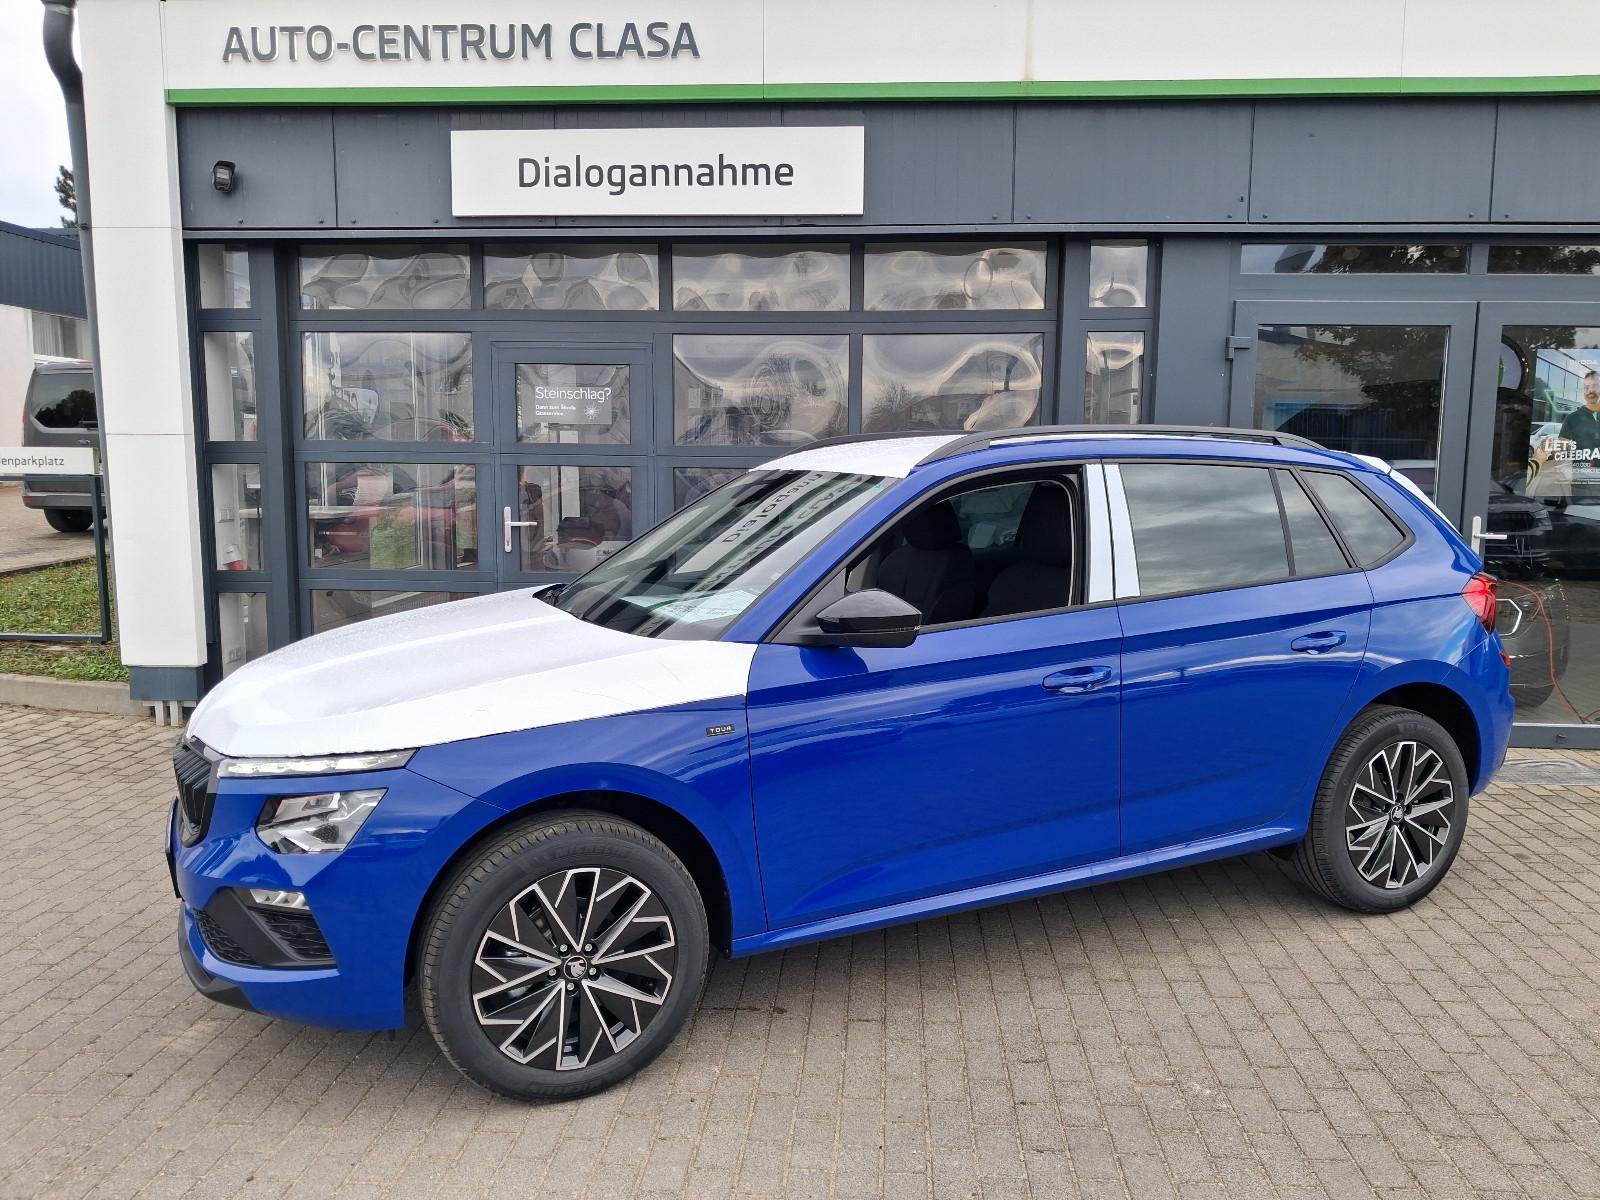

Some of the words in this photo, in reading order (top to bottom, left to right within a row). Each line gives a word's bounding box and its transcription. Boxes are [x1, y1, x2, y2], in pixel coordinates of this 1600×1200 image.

[222, 23, 553, 62] AUTO-CENTRUM
[568, 22, 700, 60] CLASA
[518, 153, 794, 196] Dialogannahme
[535, 386, 612, 403] Steinschlag?
[1544, 439, 1577, 452] LET'S
[0, 456, 65, 468] enparkplatz
[710, 725, 732, 733] TOUR
